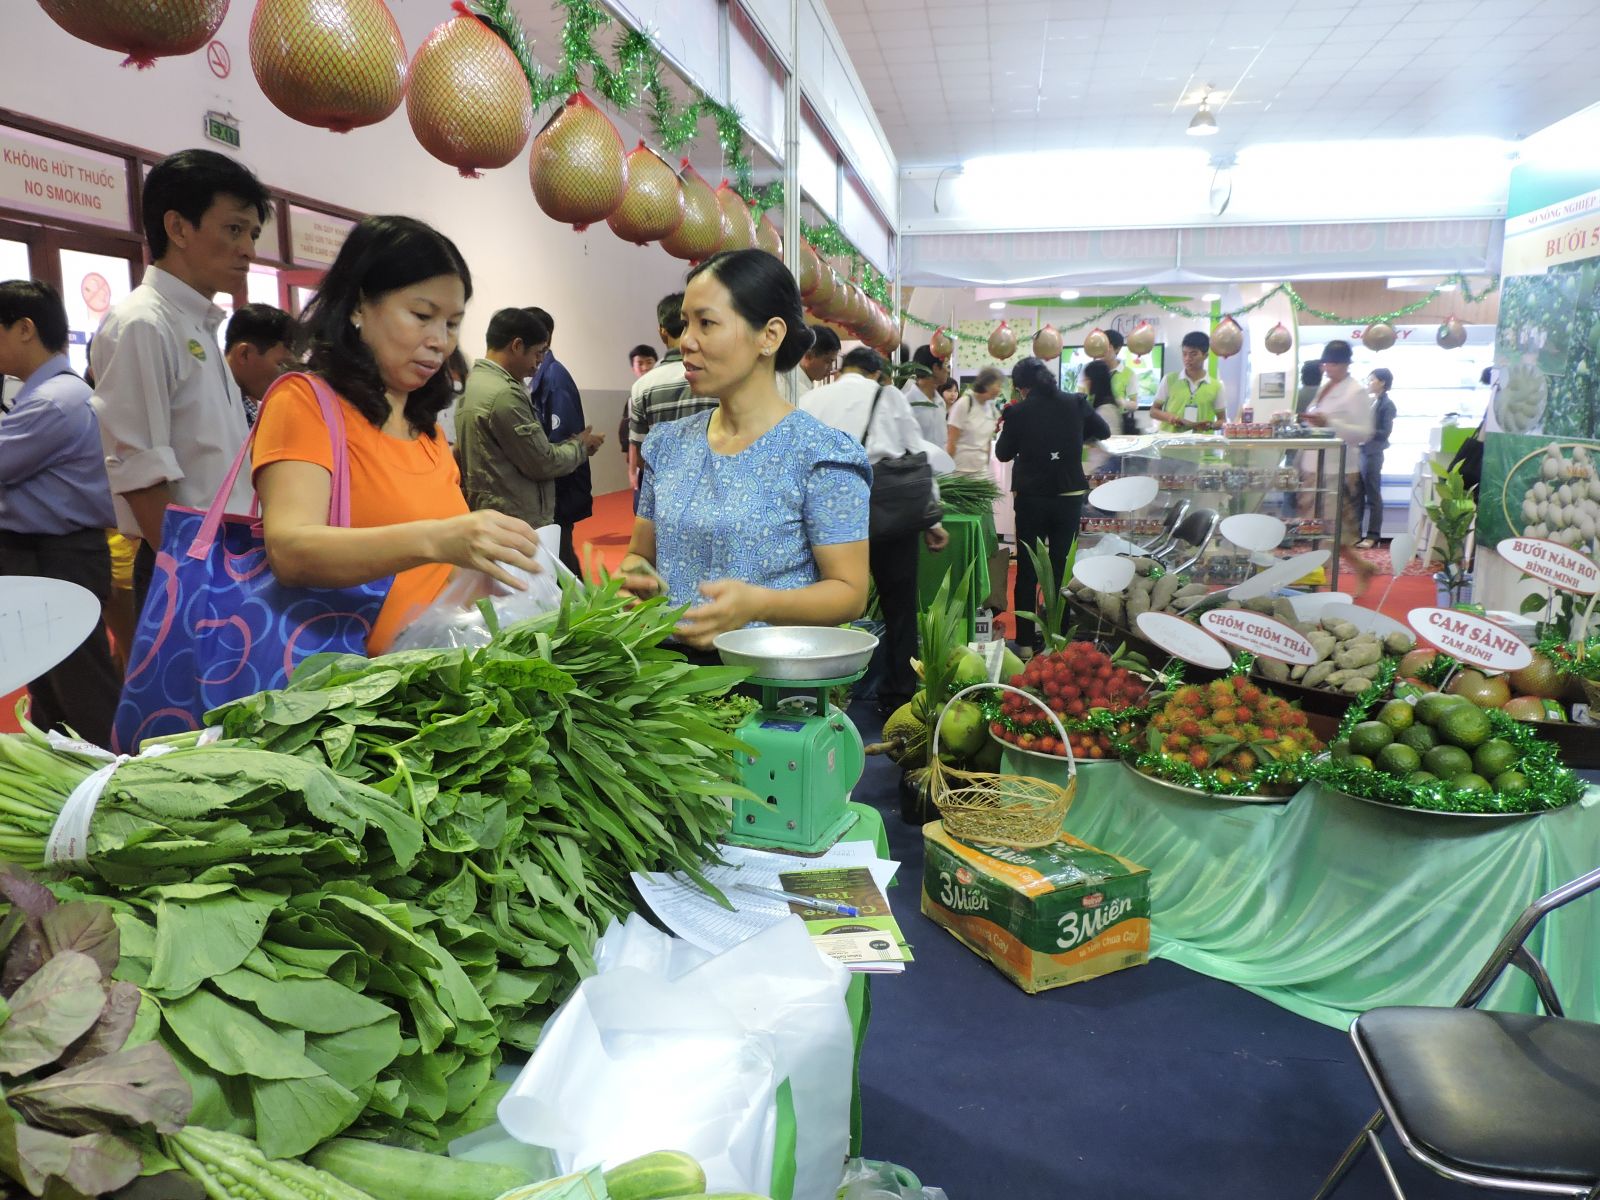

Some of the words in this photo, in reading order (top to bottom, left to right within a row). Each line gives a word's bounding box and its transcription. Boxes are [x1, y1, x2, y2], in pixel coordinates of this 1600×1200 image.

[210, 121, 239, 146] EXIT
[4, 149, 48, 173] KHÔNG
[51, 160, 74, 179] HÚT
[78, 168, 115, 189] THUỐC
[24, 179, 43, 197] NO
[46, 184, 101, 210] SMOKING
[1553, 570, 1580, 588] MINH
[1577, 563, 1597, 581] ROI
[1208, 613, 1245, 632] CHÔM
[1246, 624, 1281, 643] CHÔM
[1283, 636, 1312, 657] THÁI
[1429, 612, 1469, 637] CAM
[1441, 635, 1465, 650] TAM
[814, 890, 854, 901] Tea
[940, 871, 954, 906] 3
[952, 885, 989, 911] Miền
[1056, 912, 1079, 949] 3
[1076, 898, 1133, 944] Miền
